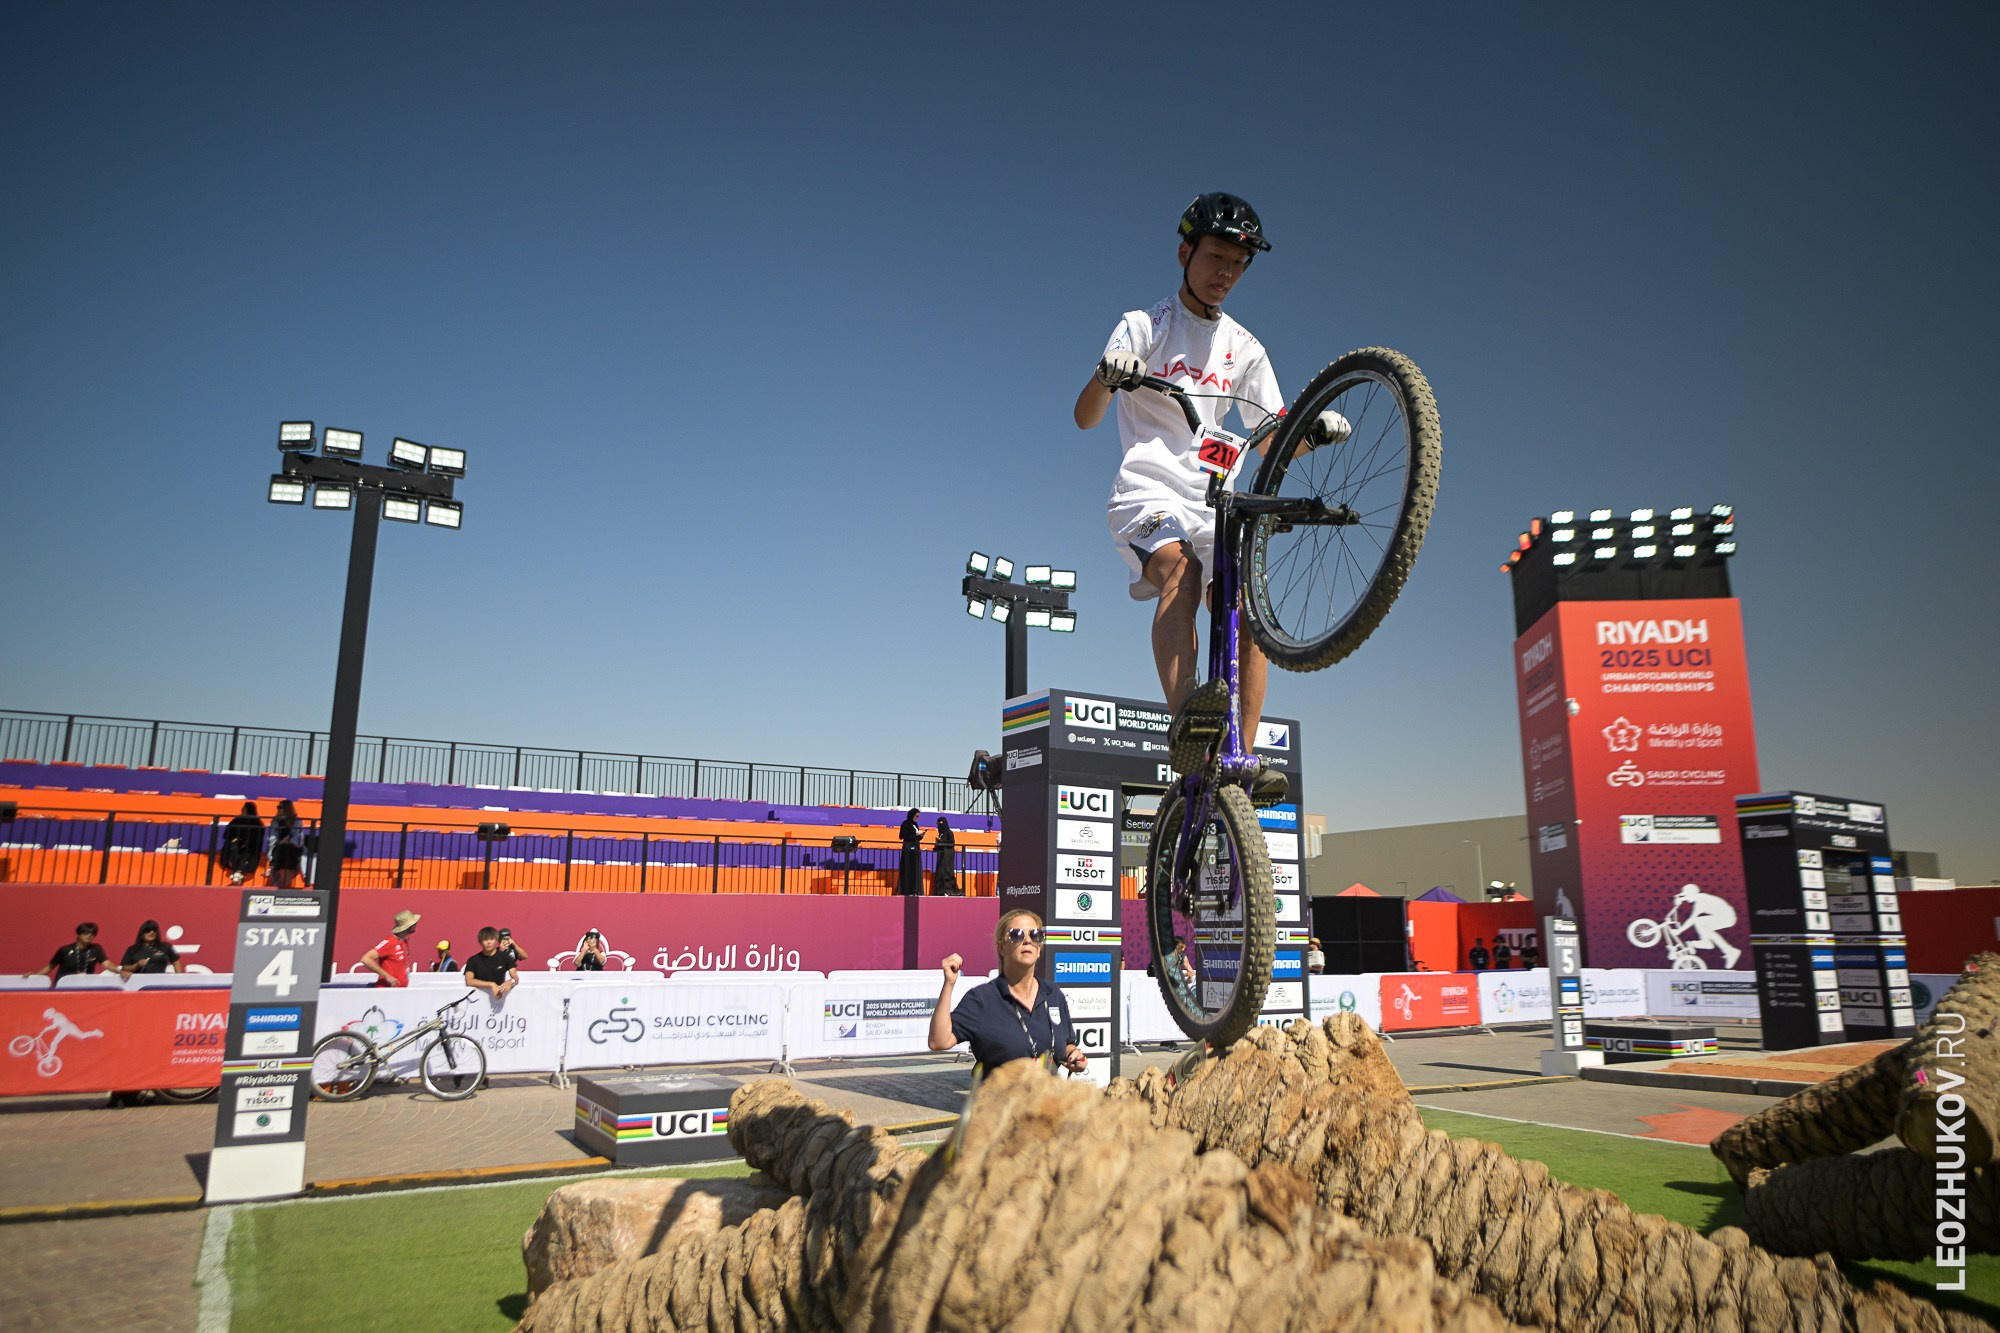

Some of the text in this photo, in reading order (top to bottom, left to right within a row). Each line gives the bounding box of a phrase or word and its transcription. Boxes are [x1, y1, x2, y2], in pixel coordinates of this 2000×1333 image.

[1152, 360, 1233, 392] JAPAN
[1206, 443, 1234, 466] 211
[1597, 619, 1708, 645] RIYADH
[1600, 649, 1712, 667] 2025 UCI
[1601, 671, 1714, 681] URBAN CYCLING WORLD
[1602, 682, 1715, 693] CHAMPIONSHIPS
[1074, 702, 1112, 725] UCI
[1118, 709, 1174, 723] 2025 URBAN CY
[1119, 718, 1170, 732] WORLD CHAM
[1157, 763, 1181, 782] FI
[1646, 770, 1725, 779] SAUDI CYCLING
[1069, 791, 1107, 812] UCI
[1255, 809, 1296, 821] SHIMANO
[1627, 817, 1651, 827] UCI
[1065, 868, 1105, 878] TISSOT
[1205, 876, 1230, 884] TISSO
[1006, 885, 1041, 897] #Riyadh2025
[243, 927, 320, 946] START
[1072, 930, 1095, 942] UCI
[1213, 931, 1230, 941] UCI
[1277, 931, 1287, 941] CI
[1554, 936, 1578, 947] START
[652, 943, 800, 972] وزارة الرياضة
[1561, 948, 1575, 974] 5
[1056, 962, 1111, 974] SHIMANO
[1273, 959, 1301, 969] MANO
[256, 949, 298, 997] 4
[1441, 986, 1468, 996] RIYADH
[1677, 983, 1699, 992] UCI
[1850, 991, 1878, 1003] UCI
[832, 1004, 861, 1017] UCI
[176, 1013, 229, 1030] RIYA
[248, 1013, 299, 1025] SHIMANO
[486, 1014, 527, 1033] وزارة
[653, 1014, 769, 1028] SAUDI CYCLING
[174, 1033, 218, 1046] 2025
[488, 1036, 525, 1051] Sport
[1603, 1040, 1631, 1052] UCI
[1684, 1041, 1703, 1053] UCI
[171, 1055, 224, 1065] CHAMPION
[258, 1060, 279, 1070] UCI
[234, 1073, 298, 1087] #Riyadh2025
[245, 1096, 286, 1105] TISSOT
[656, 1112, 708, 1136] UCI
